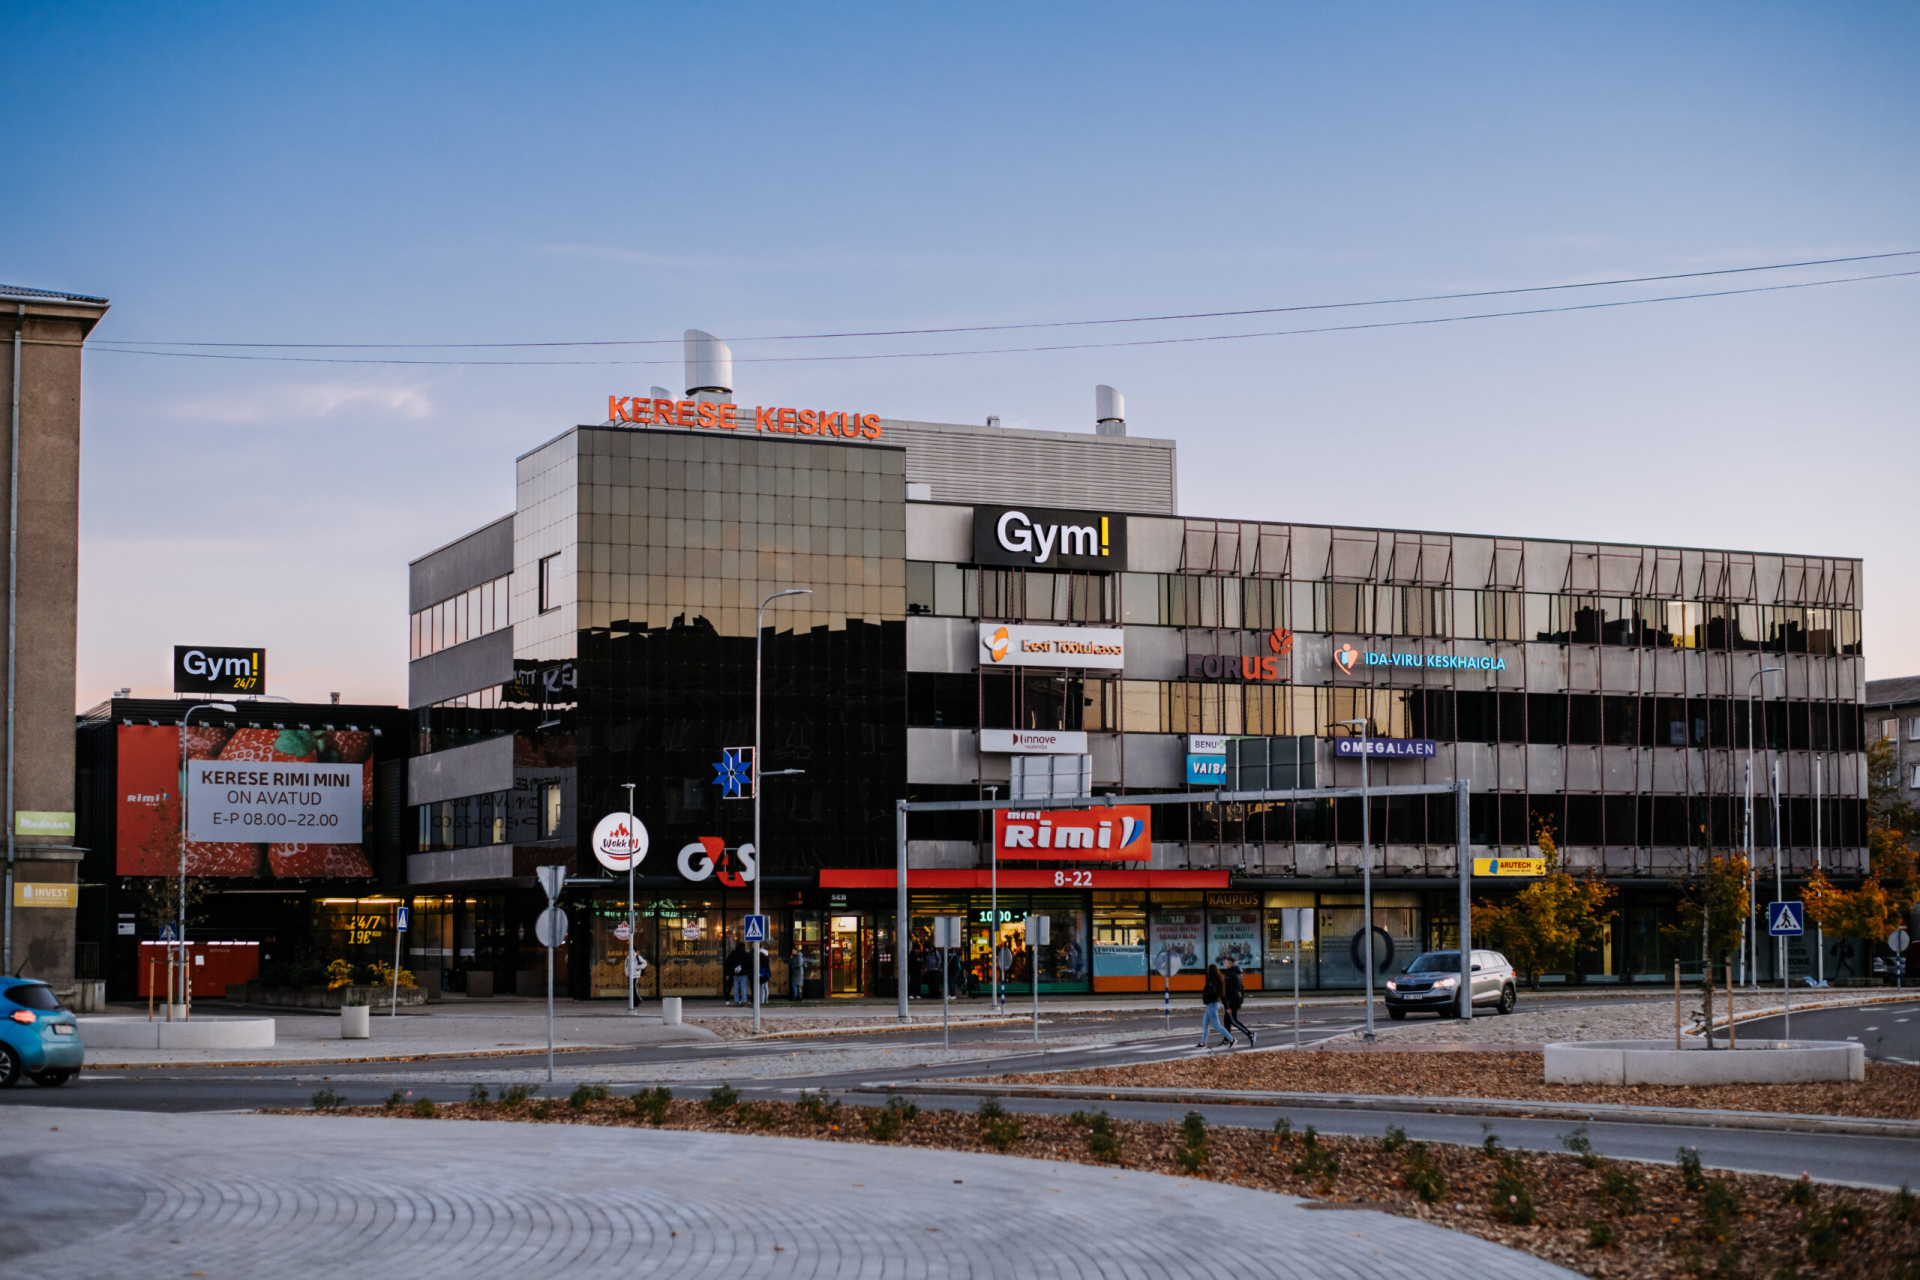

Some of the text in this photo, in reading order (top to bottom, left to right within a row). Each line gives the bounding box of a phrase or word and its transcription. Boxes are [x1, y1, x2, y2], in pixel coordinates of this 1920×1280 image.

[609, 395, 882, 439] KERESE KESKUS
[997, 510, 1109, 564] Gym!
[1023, 639, 1123, 655] Eesti Töötukassa
[183, 650, 258, 682] Gym!
[1187, 653, 1279, 680] FORUS
[1365, 652, 1507, 671] IDA-VIRU KESKHAIGLA
[233, 677, 256, 690] 24/7
[1024, 736, 1056, 744] innove
[1195, 740, 1217, 749] BENU
[1340, 741, 1434, 755] OMEGALAEN
[202, 770, 351, 788] KERESE RIMI MINI
[127, 793, 160, 802] Rimi
[227, 790, 322, 806] ON AVATUD
[213, 812, 239, 825] E-P
[1007, 811, 1040, 820] mini
[1004, 820, 1112, 848] Rimi
[677, 836, 756, 887] G4S
[1500, 861, 1531, 869] ARUTECH
[1054, 871, 1093, 886] 8-22
[35, 888, 68, 897] INVEST
[831, 893, 847, 901] SEB
[1209, 894, 1259, 905] KAUPLUS
[349, 915, 381, 930] 24/7
[348, 930, 371, 945] 19€
